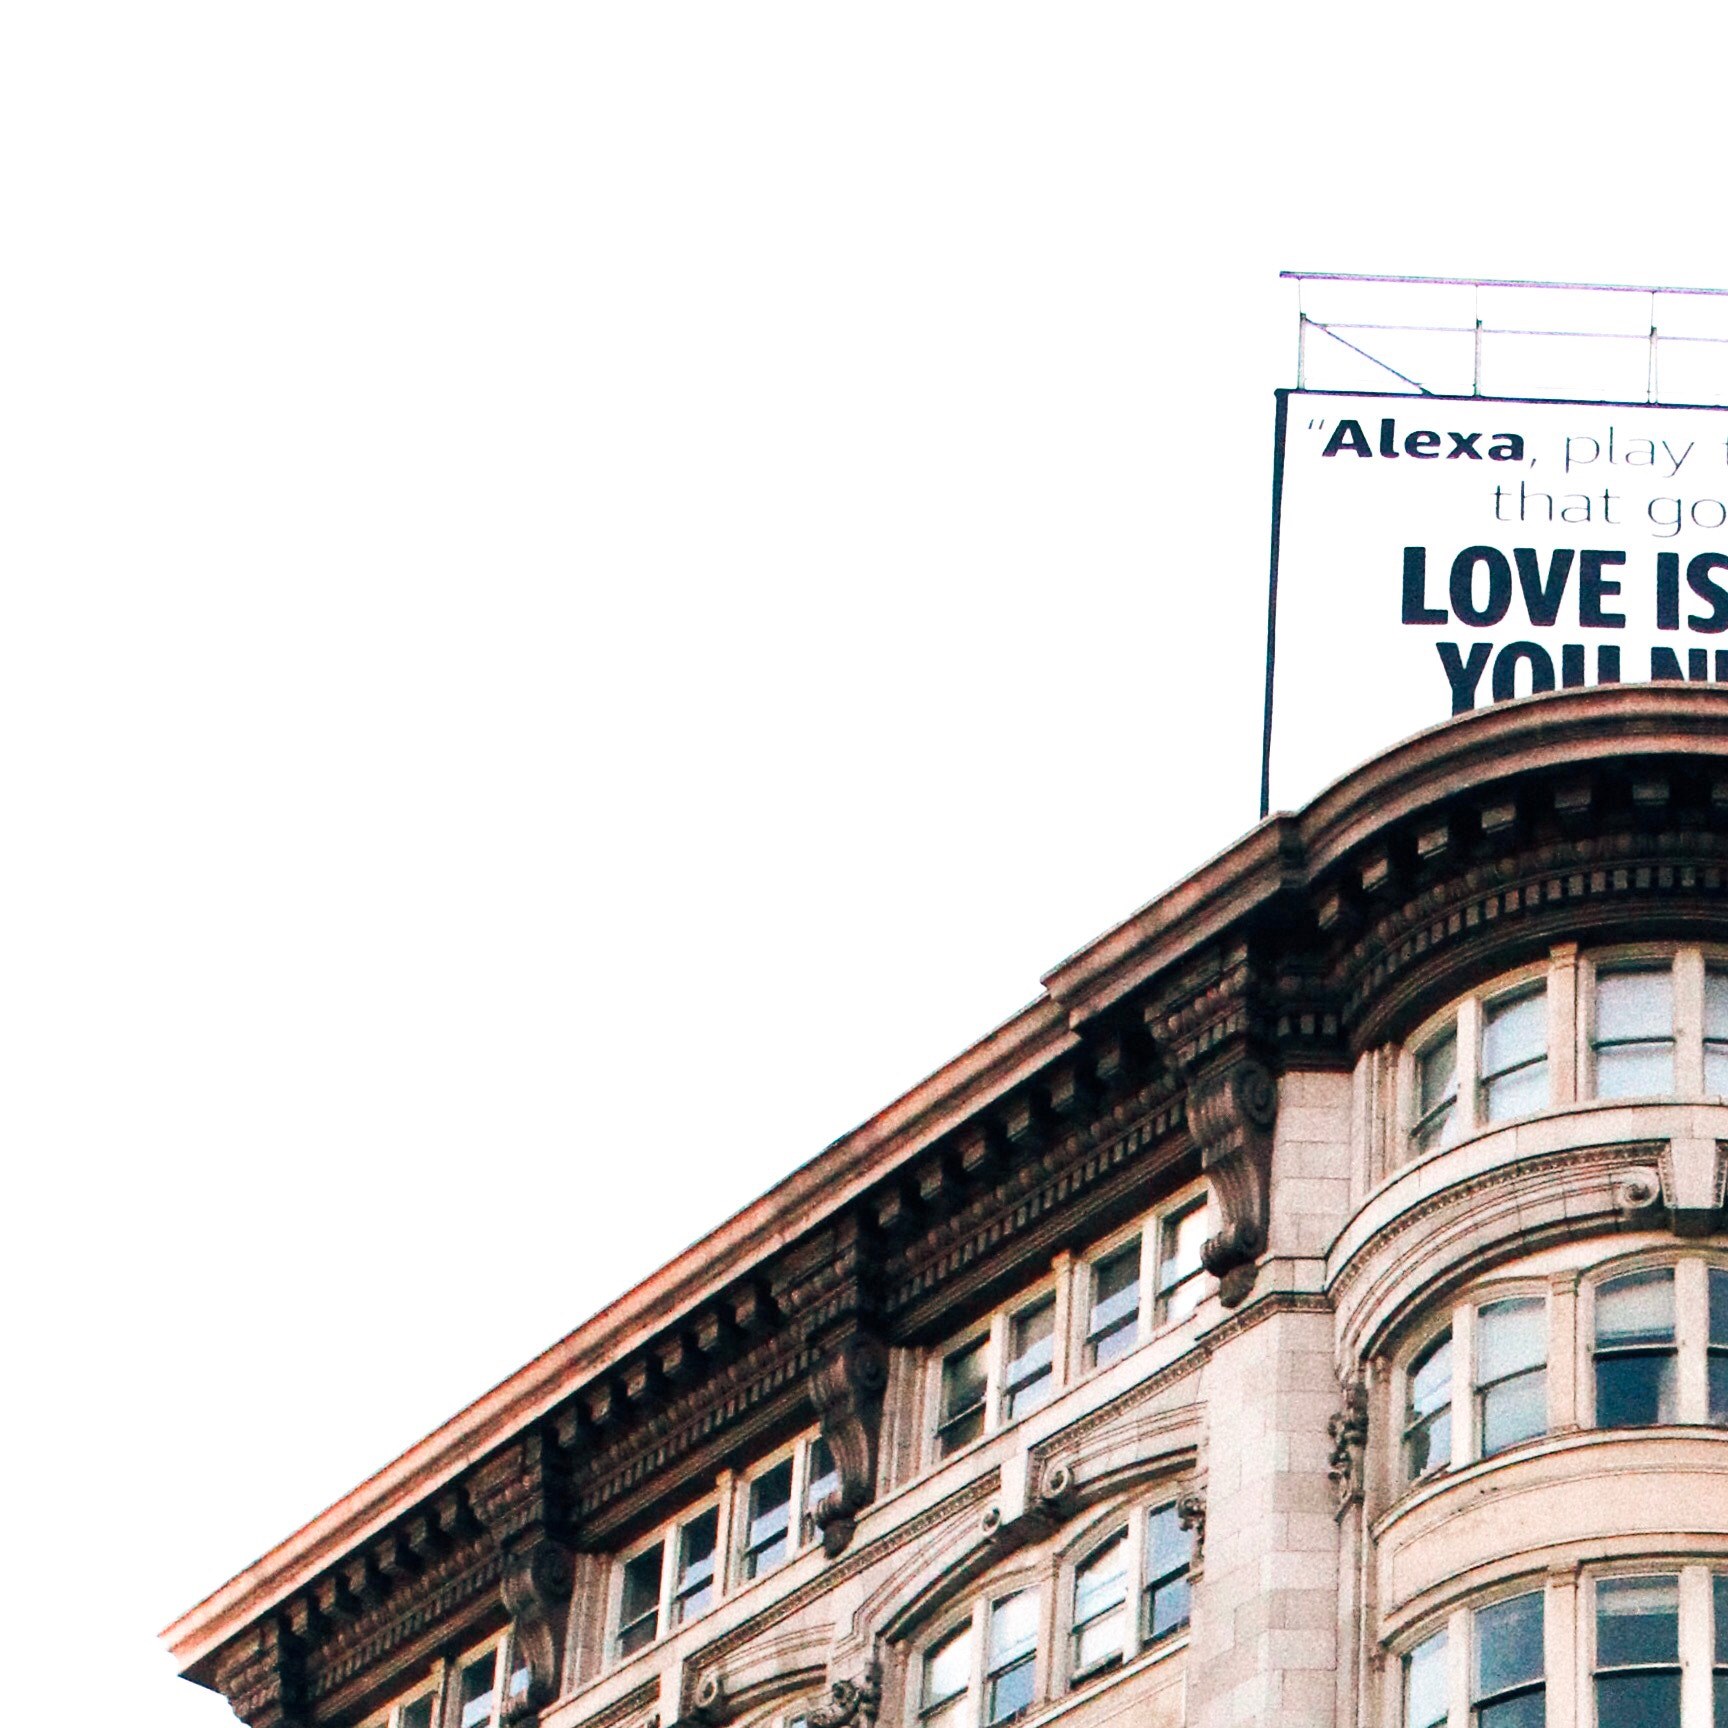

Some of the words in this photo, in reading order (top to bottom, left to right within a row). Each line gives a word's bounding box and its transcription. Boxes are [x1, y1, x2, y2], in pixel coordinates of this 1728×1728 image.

[1565, 426, 1695, 477] play
[1492, 480, 1620, 525] that
[1401, 545, 1626, 629] LOVE
